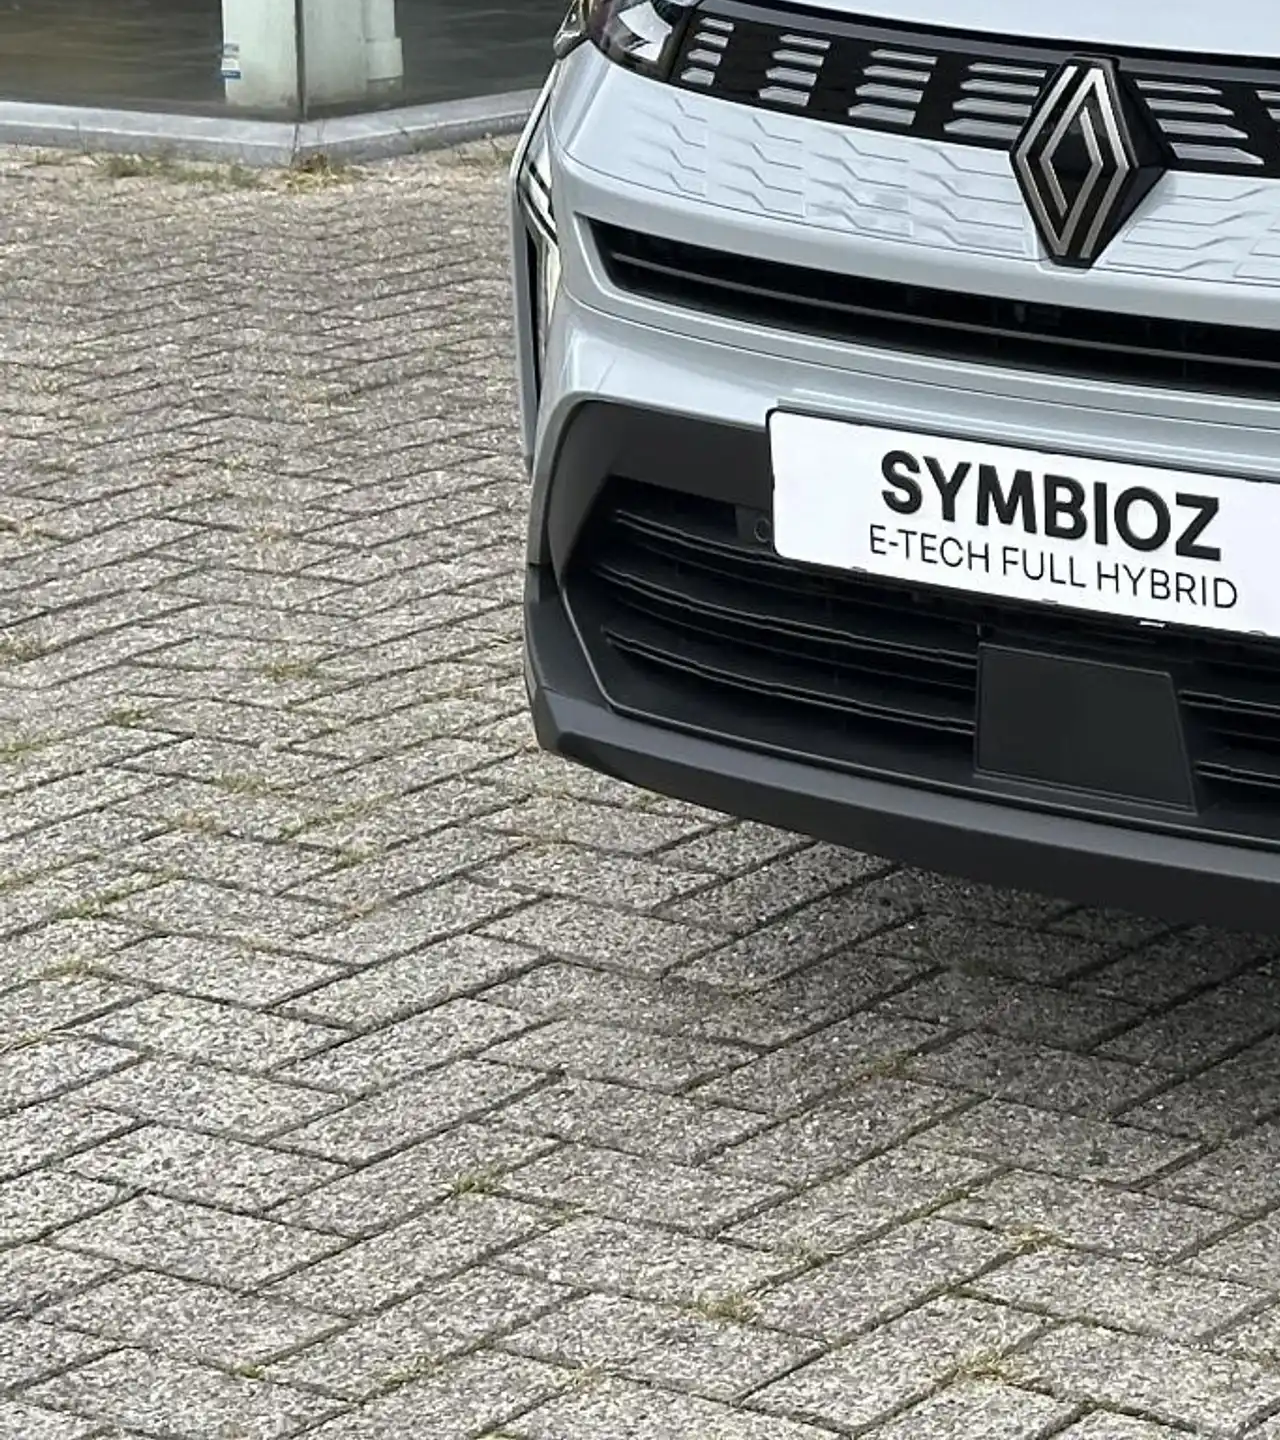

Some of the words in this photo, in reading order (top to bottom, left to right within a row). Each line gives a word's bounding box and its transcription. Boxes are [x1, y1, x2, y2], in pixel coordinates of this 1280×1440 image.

[881, 449, 1221, 562] SYMBIOZ
[870, 523, 989, 573] E-TECH
[1002, 546, 1086, 589] FULL
[1097, 560, 1238, 610] HYBRID
